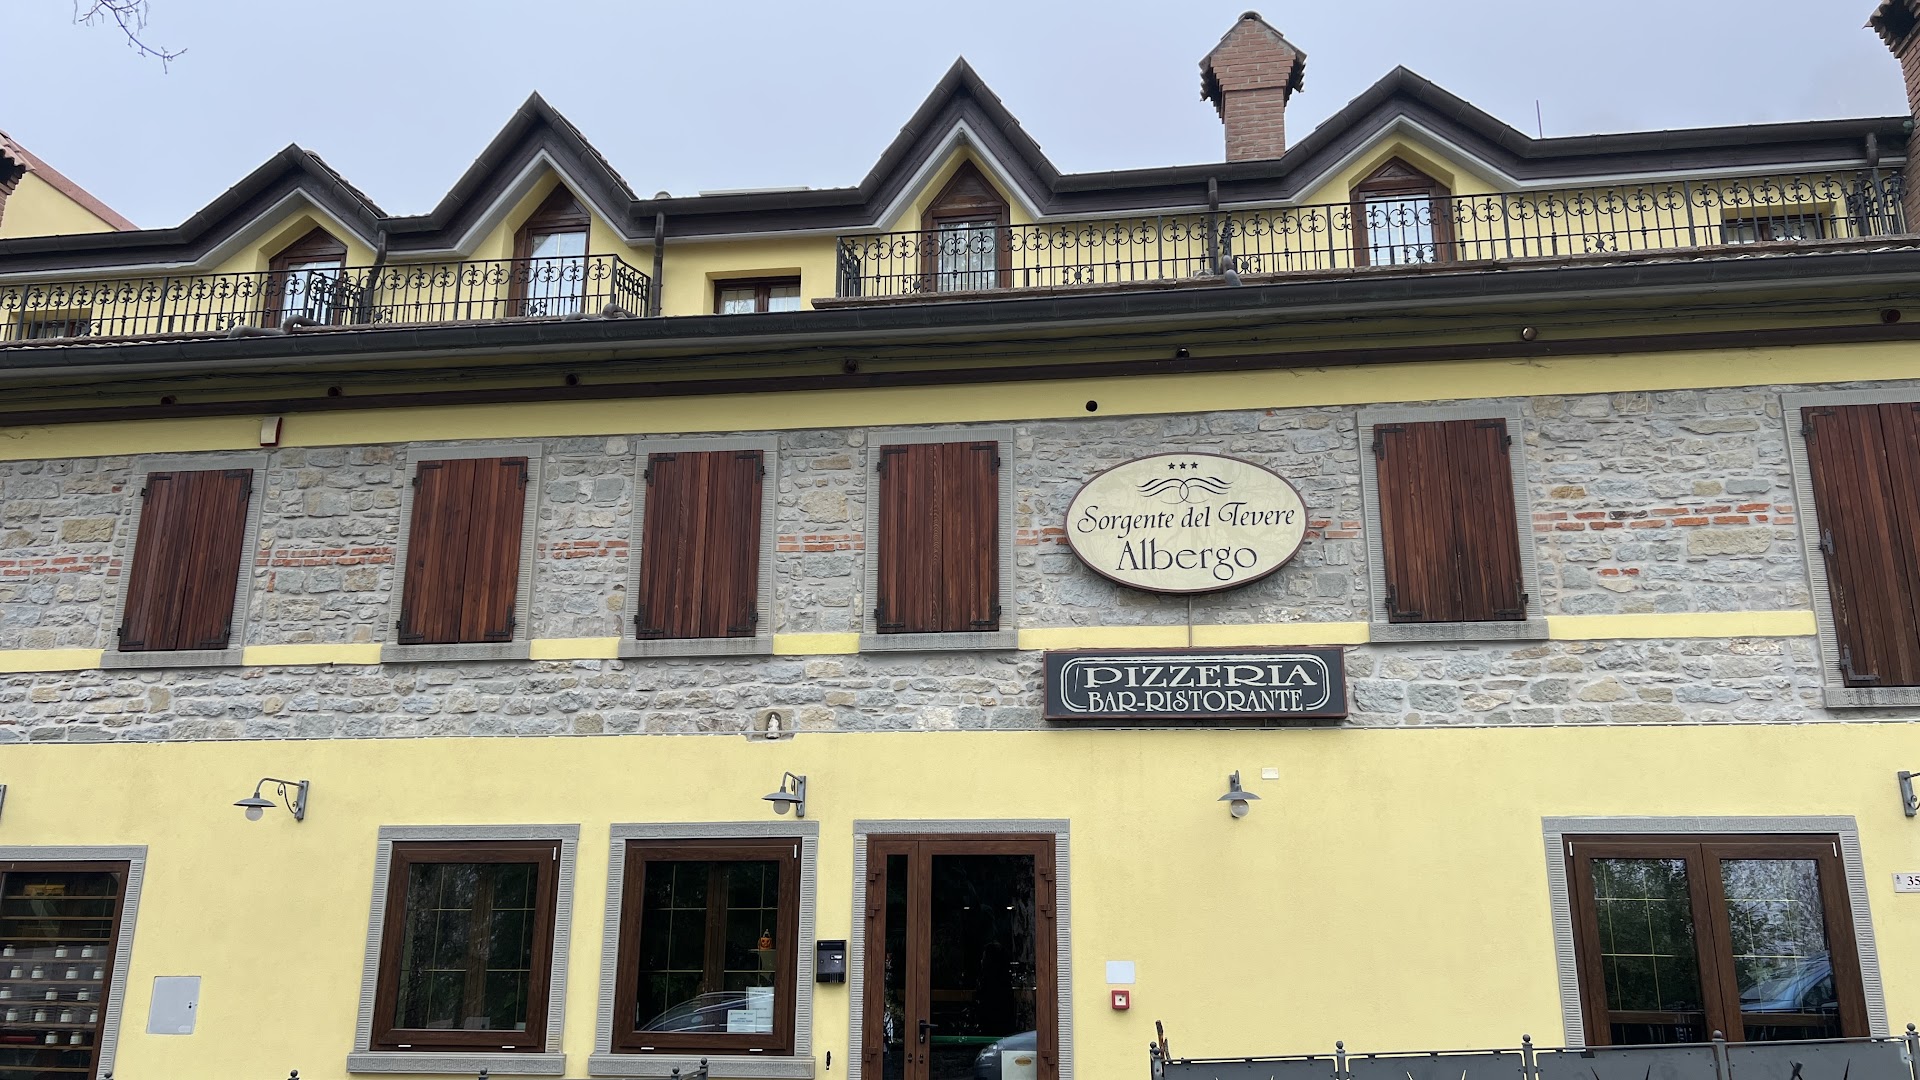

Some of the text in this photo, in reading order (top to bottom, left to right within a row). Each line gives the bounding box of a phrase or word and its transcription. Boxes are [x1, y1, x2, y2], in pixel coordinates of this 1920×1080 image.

[1077, 502, 1295, 538] Sorgente del Tevere
[1115, 538, 1257, 581] Albergo
[1083, 664, 1318, 688] PIZZERIA
[1086, 689, 1304, 713] BAR-RISTORANTE
